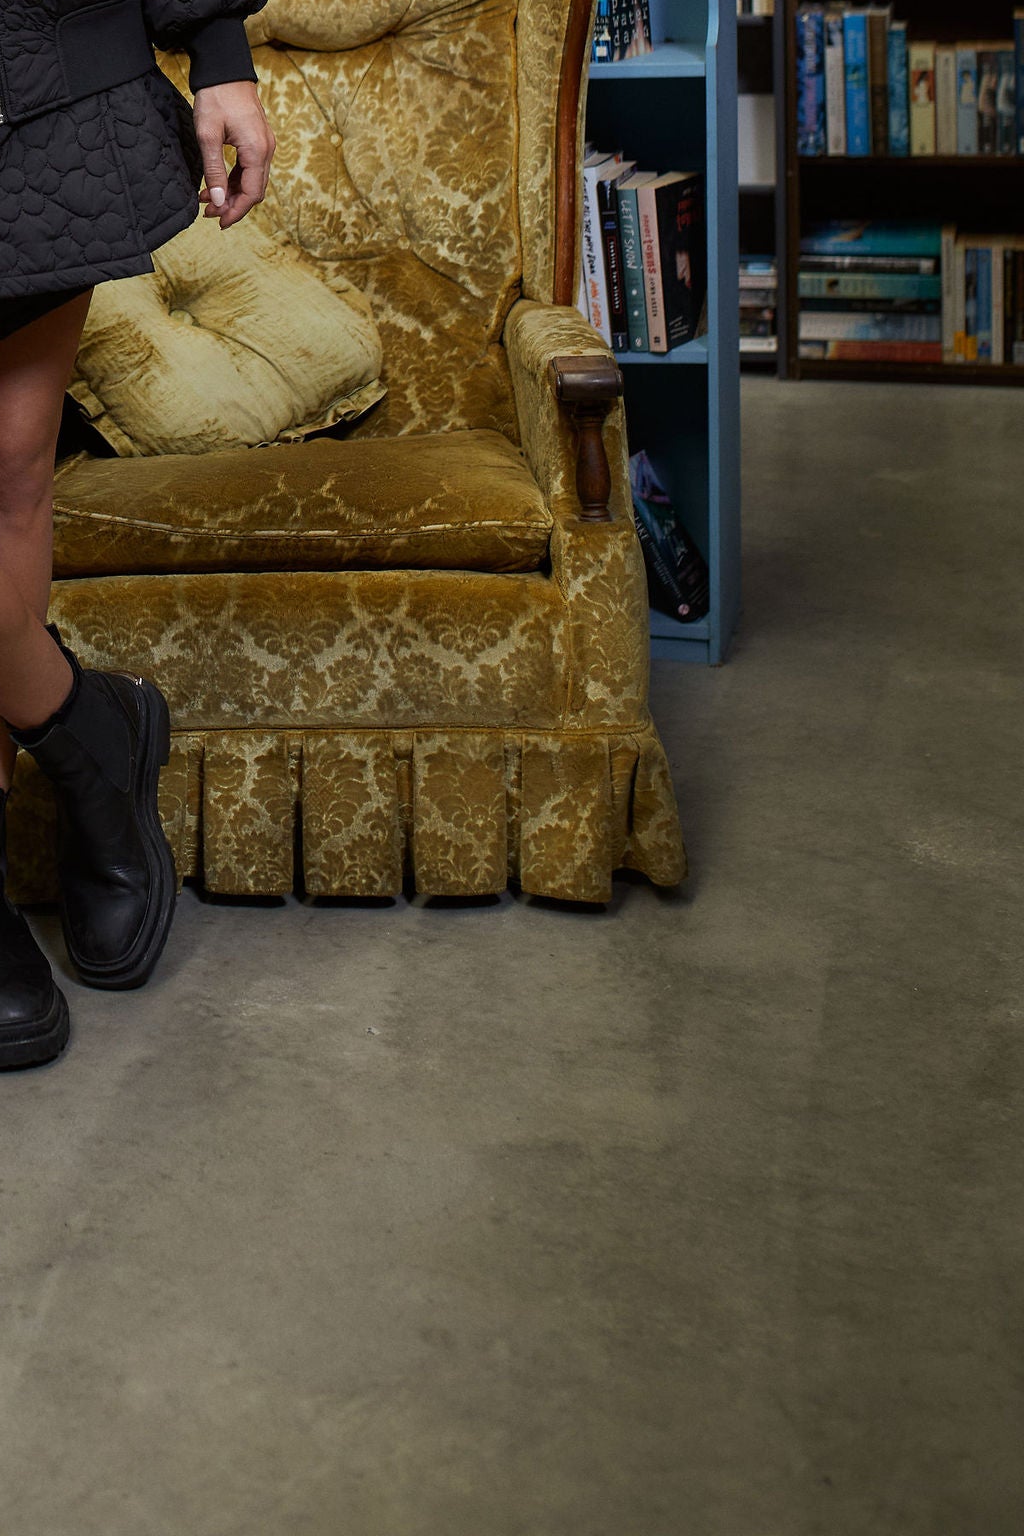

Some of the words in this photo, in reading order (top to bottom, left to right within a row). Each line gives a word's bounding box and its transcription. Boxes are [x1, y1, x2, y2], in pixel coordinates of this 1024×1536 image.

[613, 7, 648, 28] water
[614, 25, 649, 47] dawn
[620, 199, 633, 225] LET
[624, 224, 634, 239] IT
[625, 239, 638, 270] SNOW
